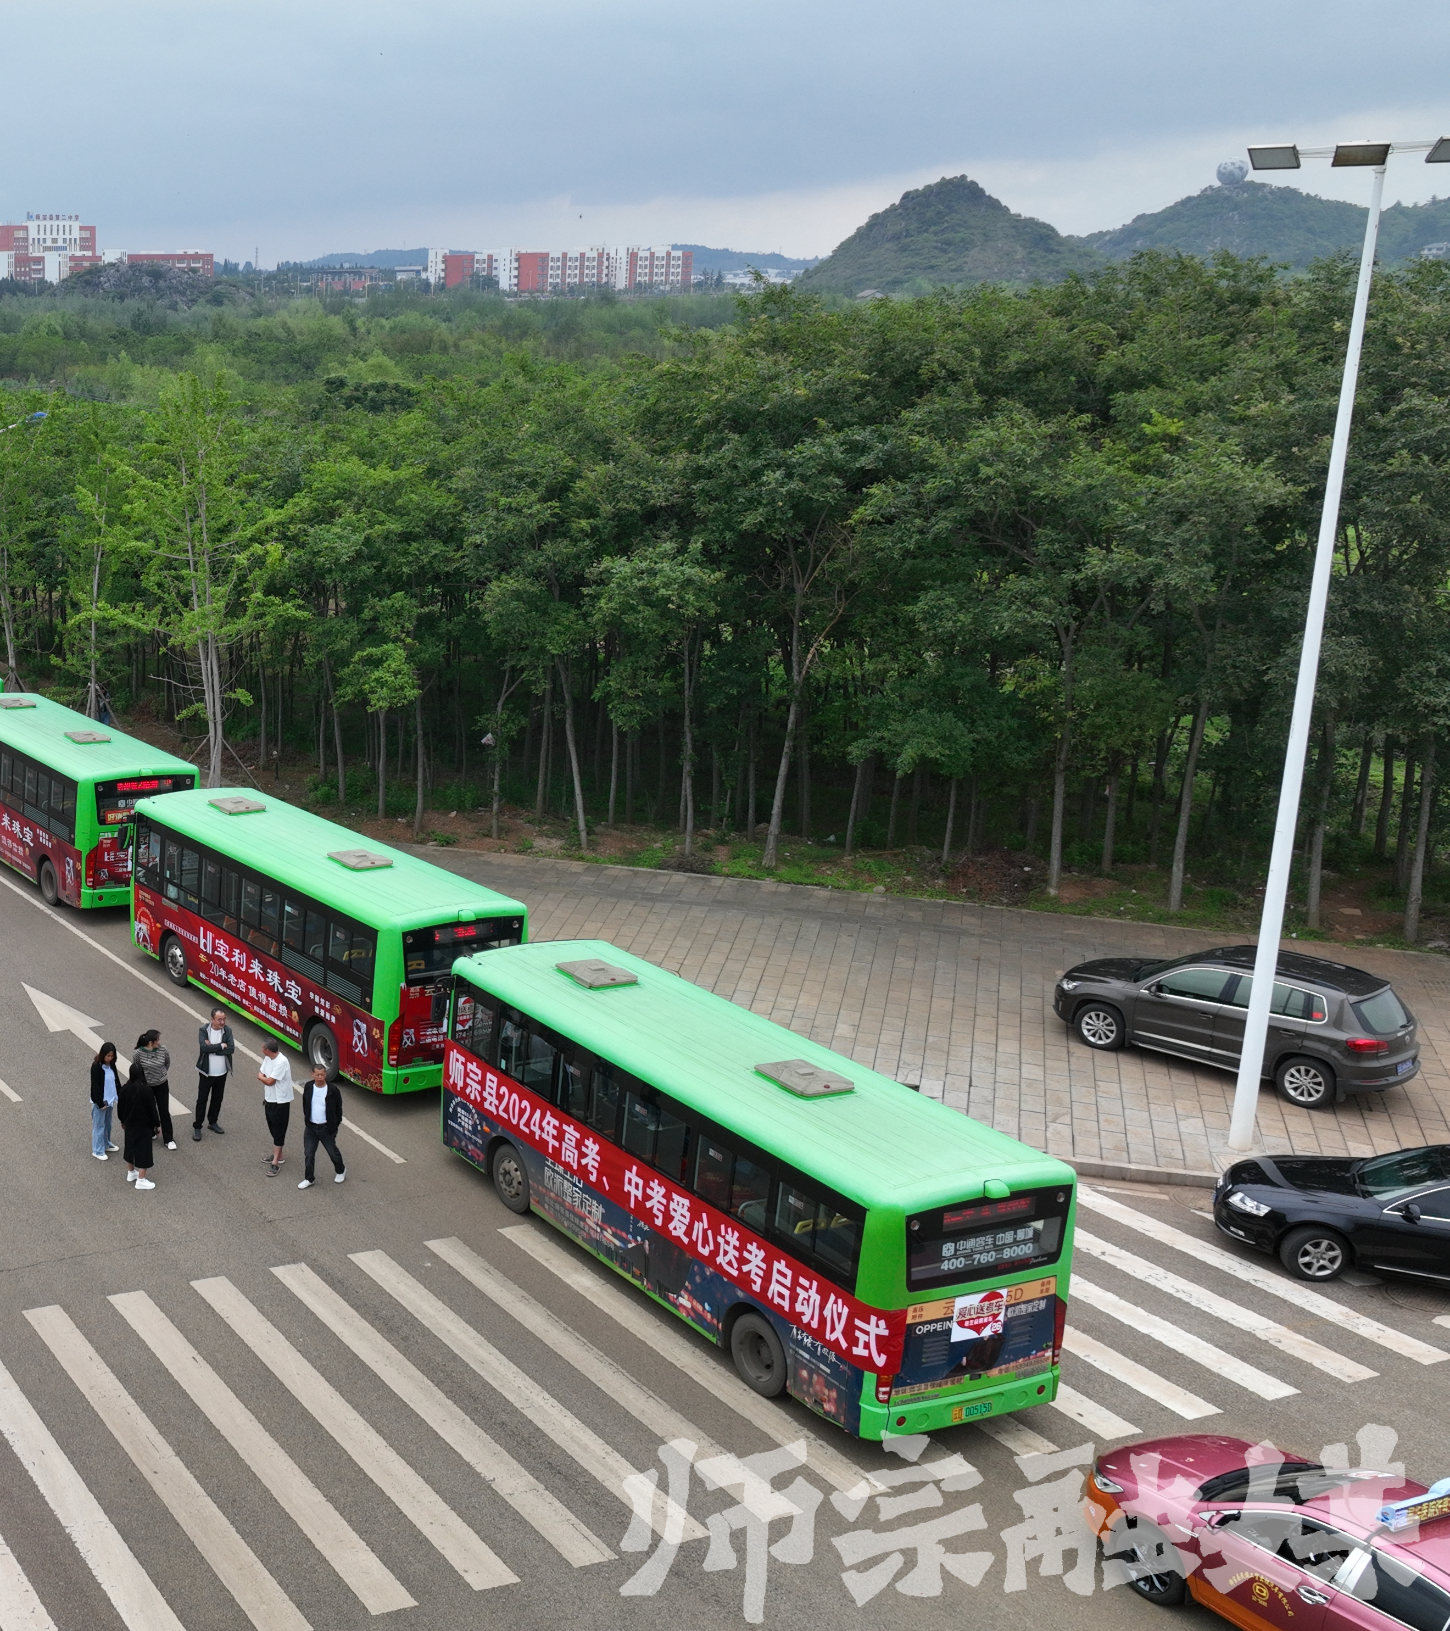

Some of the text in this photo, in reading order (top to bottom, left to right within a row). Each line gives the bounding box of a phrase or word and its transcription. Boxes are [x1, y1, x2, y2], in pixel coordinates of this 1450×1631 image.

[213, 938, 303, 1006] 宝利来珠宝
[209, 960, 246, 992] 20年老店
[248, 985, 289, 1019] 值得信赖
[449, 1048, 890, 1368] 师宗县2024年高考、中考爱心送考启动仪式
[544, 1166, 603, 1225] 欧派整家定制
[956, 1234, 995, 1251] 中通客车
[940, 1242, 1034, 1271] 400-760-8000
[911, 1306, 925, 1314] 高压
[956, 1299, 1004, 1320] 爱心送考车
[915, 1320, 954, 1335] OPPEIN
[991, 1321, 1003, 1331] 26
